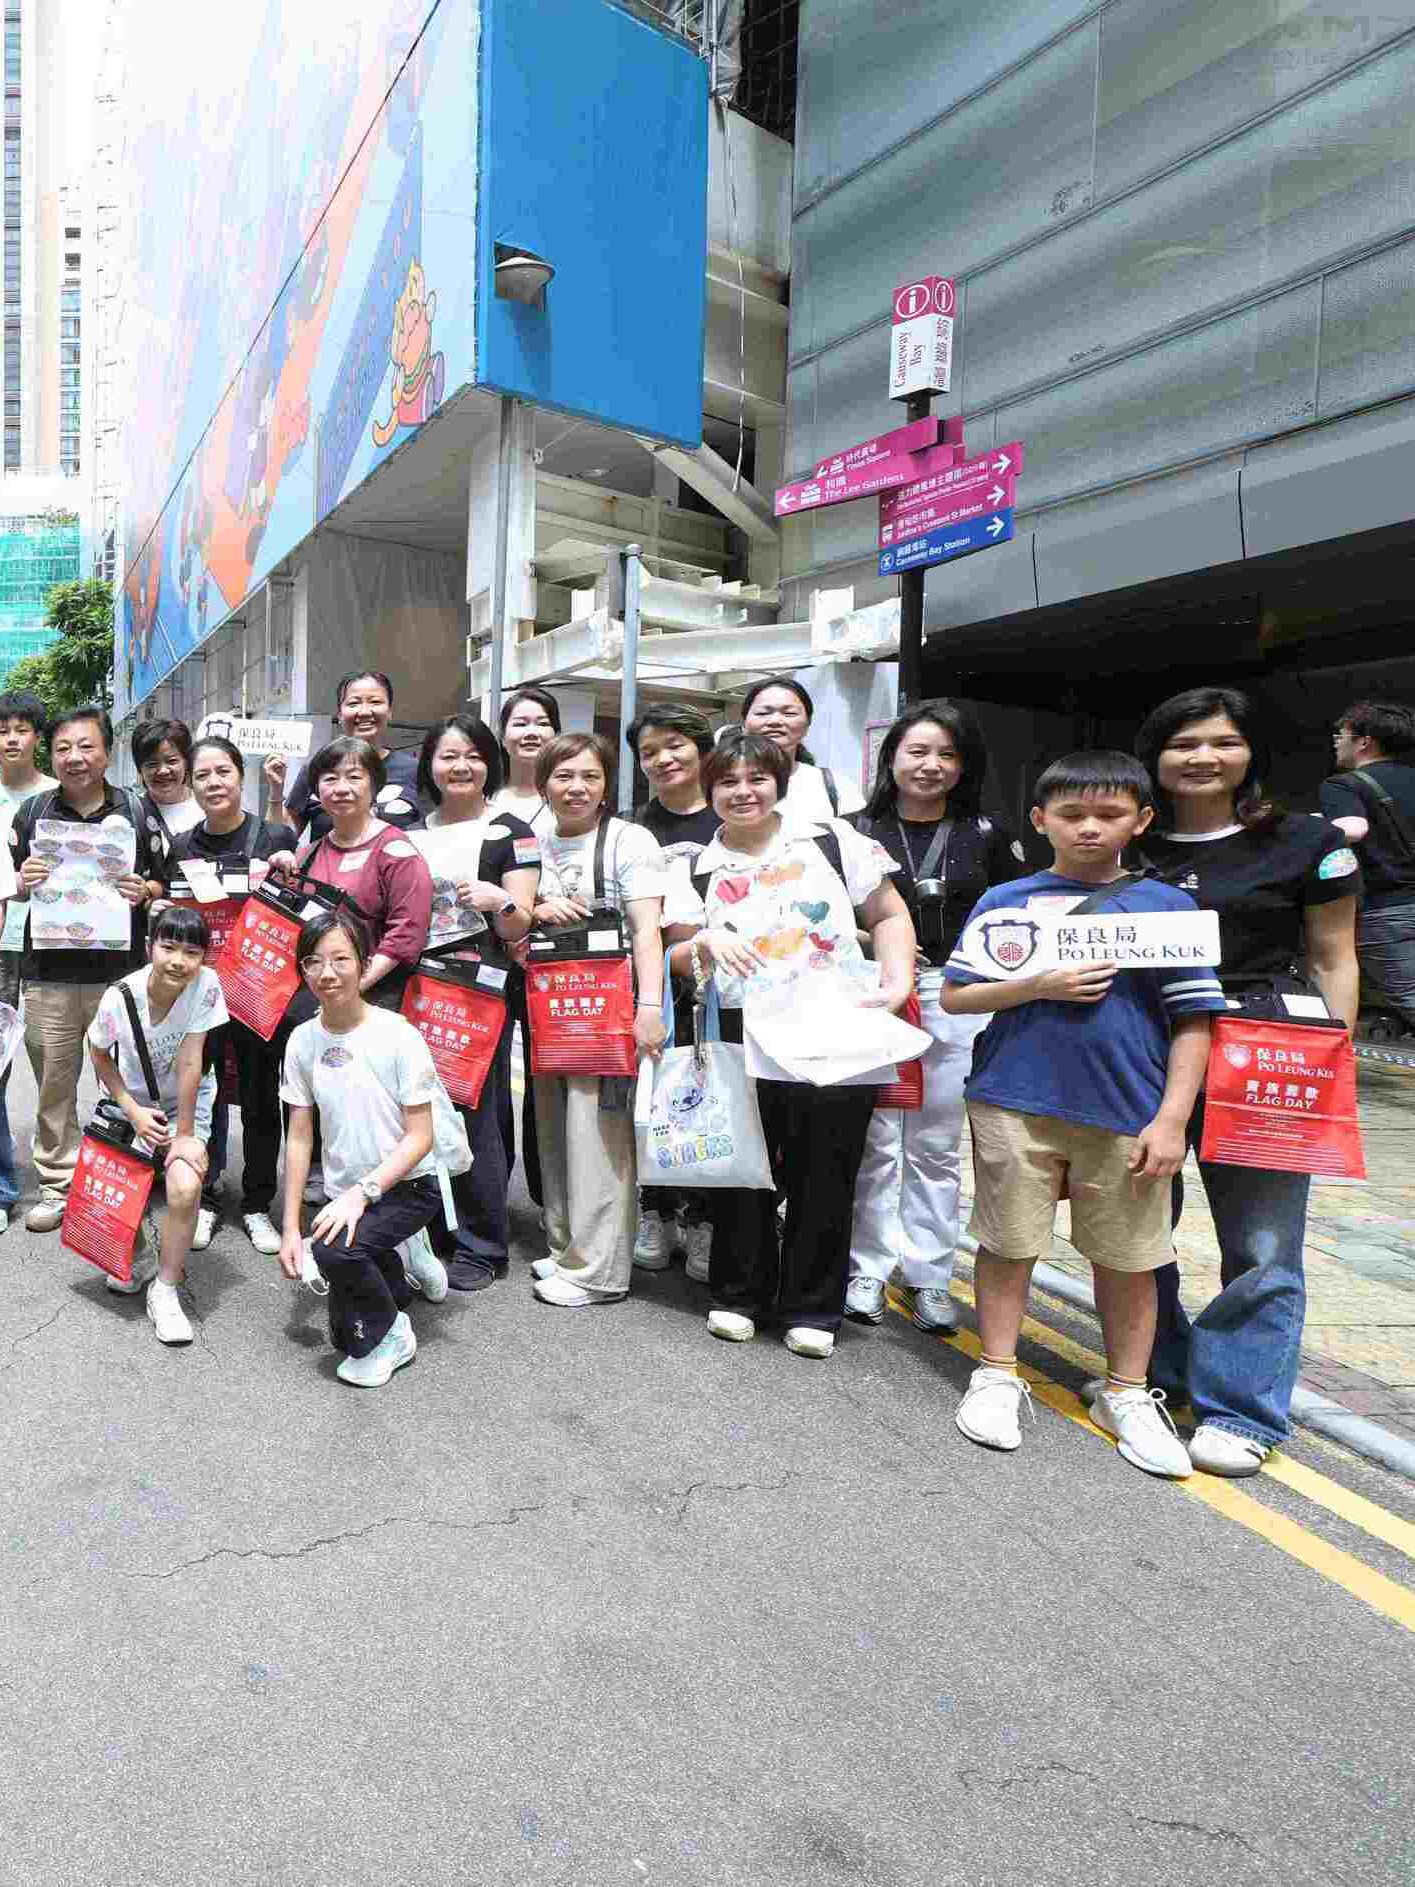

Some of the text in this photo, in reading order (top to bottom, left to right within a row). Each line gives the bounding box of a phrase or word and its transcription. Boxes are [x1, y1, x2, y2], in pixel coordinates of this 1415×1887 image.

[894, 332, 911, 387] Causeway
[909, 344, 926, 368] Bay
[863, 473, 904, 489] Gardens
[1057, 926, 1137, 944] 保良局
[551, 1007, 603, 1017] FLAG DAY
[445, 1039, 466, 1051] DAY
[1244, 1093, 1313, 1110] FLAG DAY
[81, 1184, 122, 1209] FLAG DAY
